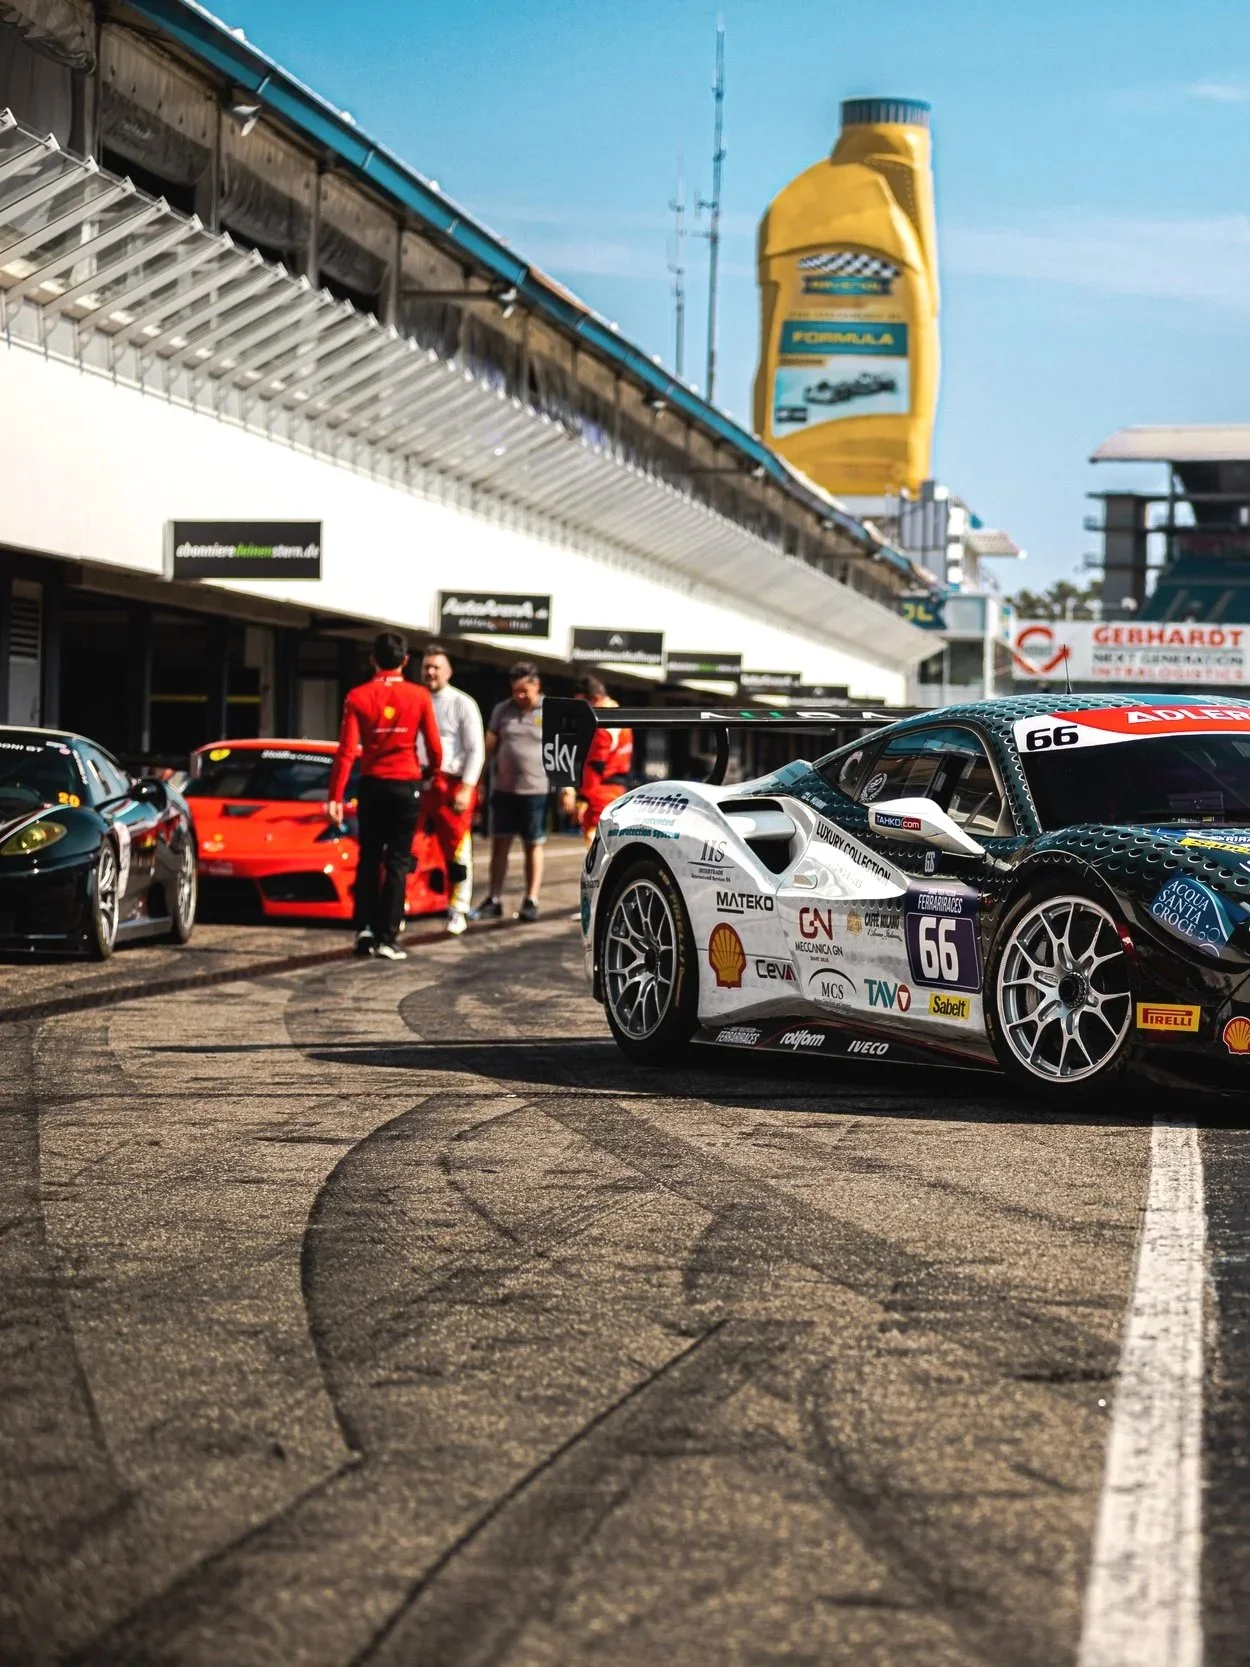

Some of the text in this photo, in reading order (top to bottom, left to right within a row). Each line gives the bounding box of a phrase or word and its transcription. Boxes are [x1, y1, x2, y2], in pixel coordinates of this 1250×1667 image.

[791, 331, 893, 345] FORMULA
[1093, 626, 1242, 646] GEBHARDT
[1026, 725, 1079, 751] 66
[543, 734, 578, 782] sky
[58, 792, 80, 808] 20
[876, 815, 920, 829] TAHKO com
[816, 821, 844, 851] LUXURY
[843, 842, 891, 880] COLLECTION
[716, 891, 774, 911] MATEKO
[918, 894, 962, 913] FERRARIRACES
[1167, 880, 1209, 911] ACQUA
[1158, 890, 1202, 924] SANTA
[1152, 902, 1196, 937] CROCE
[795, 941, 843, 956] MECCANICA GN
[919, 916, 959, 981] 66
[821, 982, 844, 1000] MCS
[932, 995, 966, 1017] Sabelt
[1142, 1008, 1193, 1026] PIRELLI
[716, 1030, 760, 1045] FERRARIRACES
[779, 1029, 826, 1051] rotiform
[847, 1040, 889, 1055] IVECO
